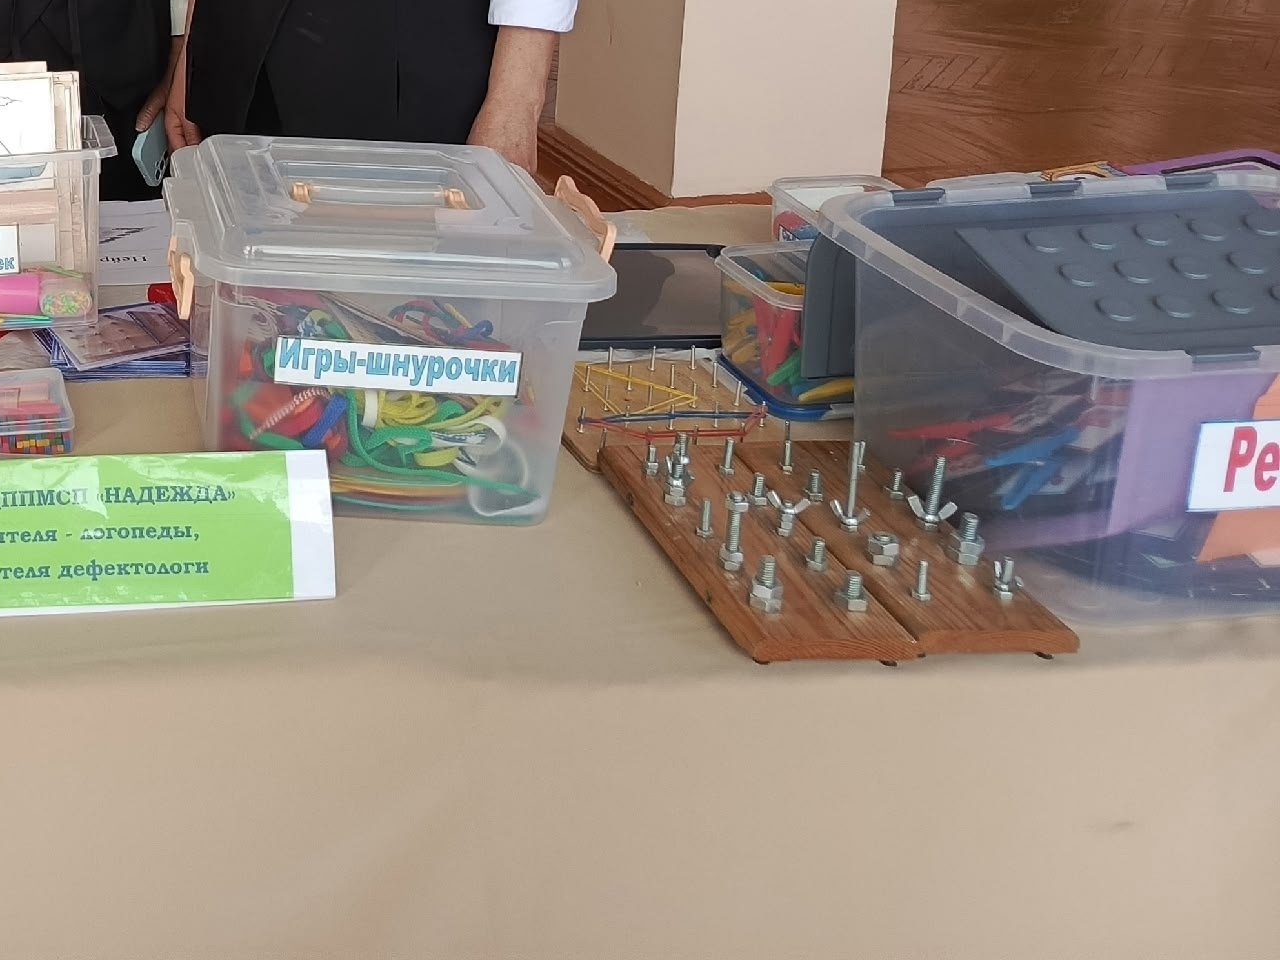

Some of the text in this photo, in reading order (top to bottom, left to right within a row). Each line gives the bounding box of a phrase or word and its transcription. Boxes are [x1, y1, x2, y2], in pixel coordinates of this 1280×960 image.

[279, 338, 517, 386] Игры-шнурочки
[1223, 426, 1280, 492] Ре
[97, 485, 235, 505] «НАДЕЖДА»
[80, 526, 199, 541] логопеды,
[57, 559, 209, 581] дефектологи
